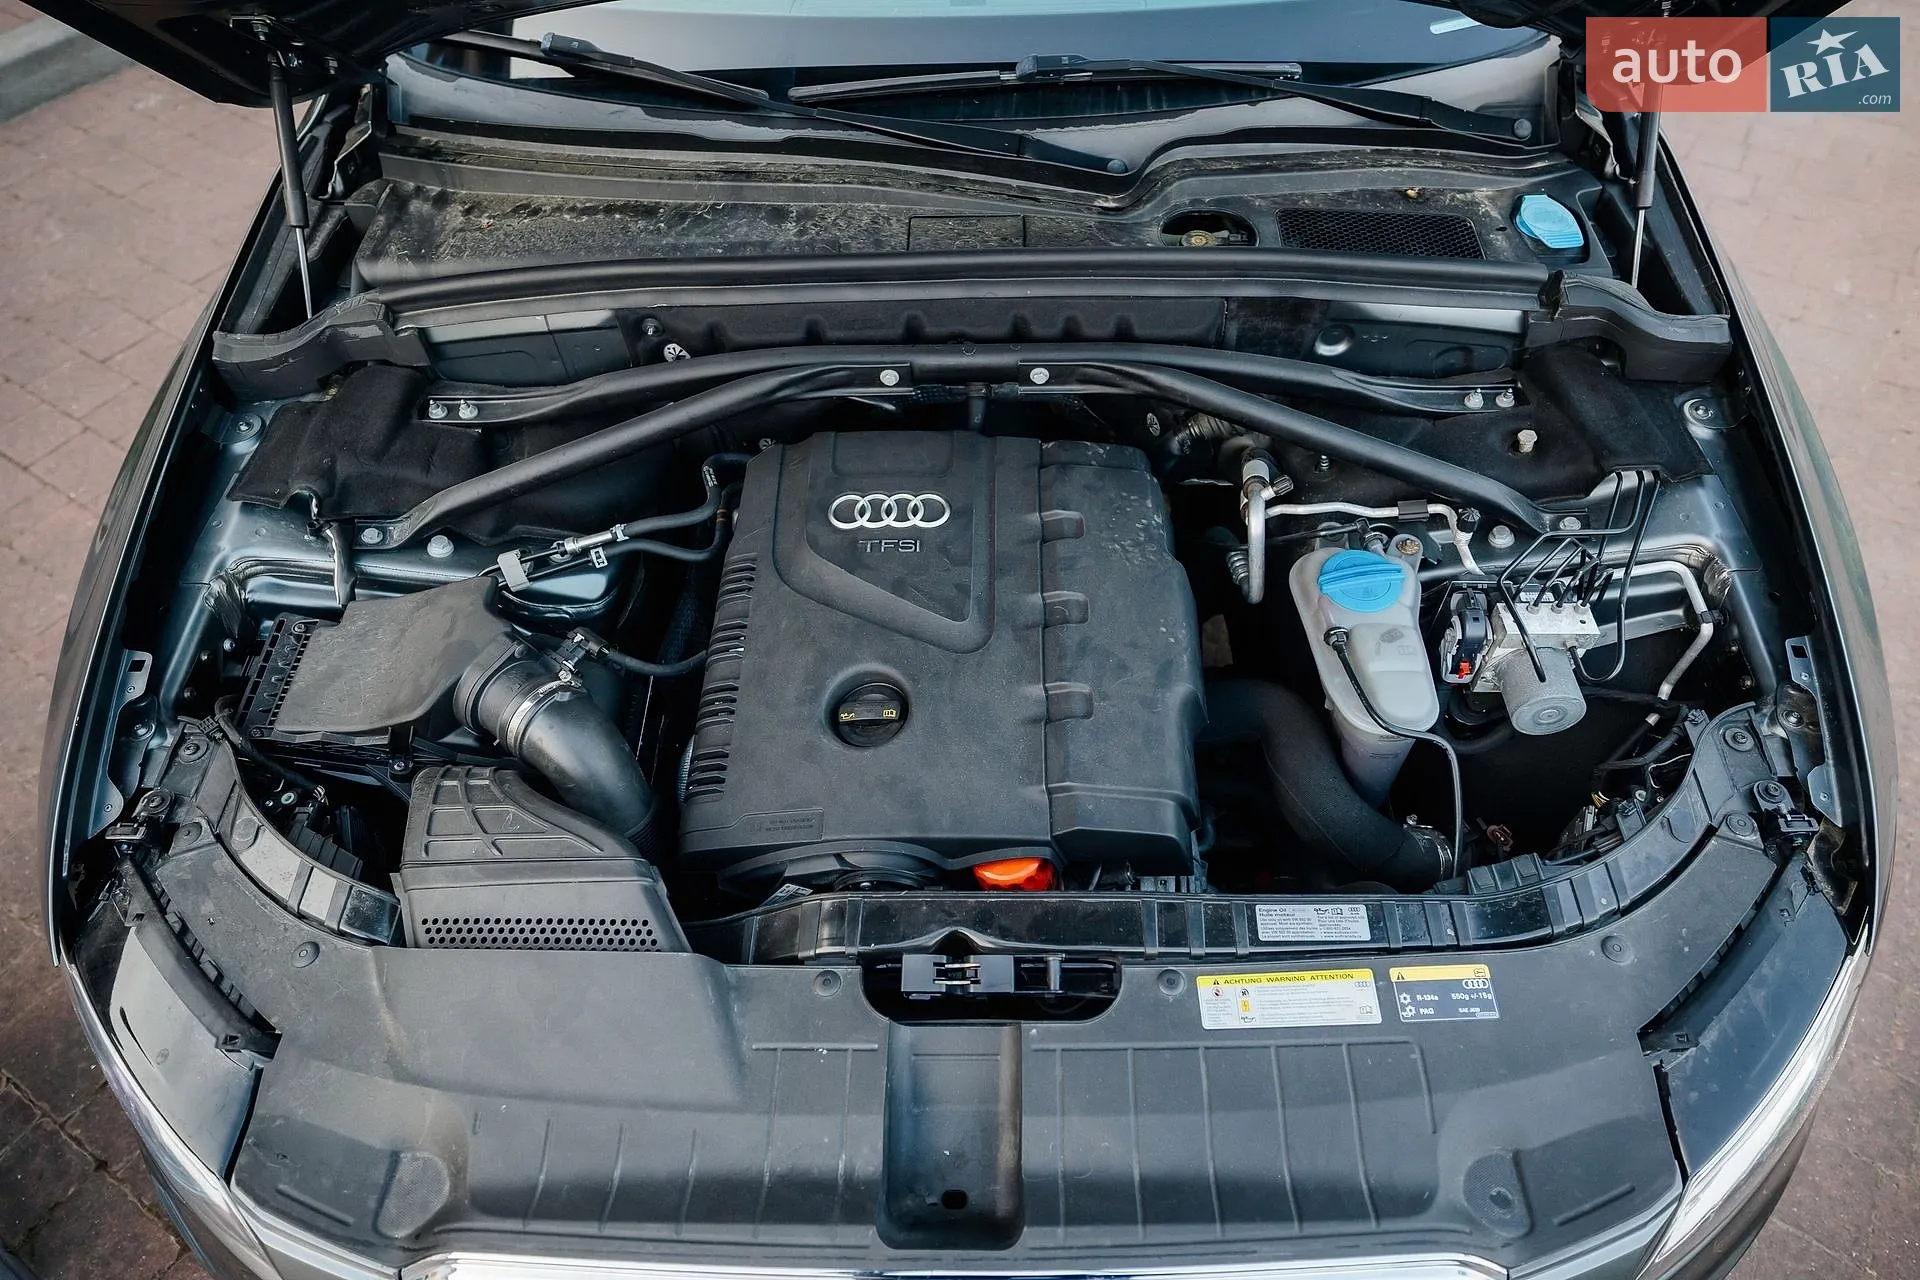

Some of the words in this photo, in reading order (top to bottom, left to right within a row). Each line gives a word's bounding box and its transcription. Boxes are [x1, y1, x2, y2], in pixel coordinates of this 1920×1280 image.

[857, 539, 920, 553] TFSI
[1223, 977, 1262, 985] ACHTUNG
[1265, 975, 1306, 983] WARNING
[1310, 973, 1354, 981] ATTENTION
